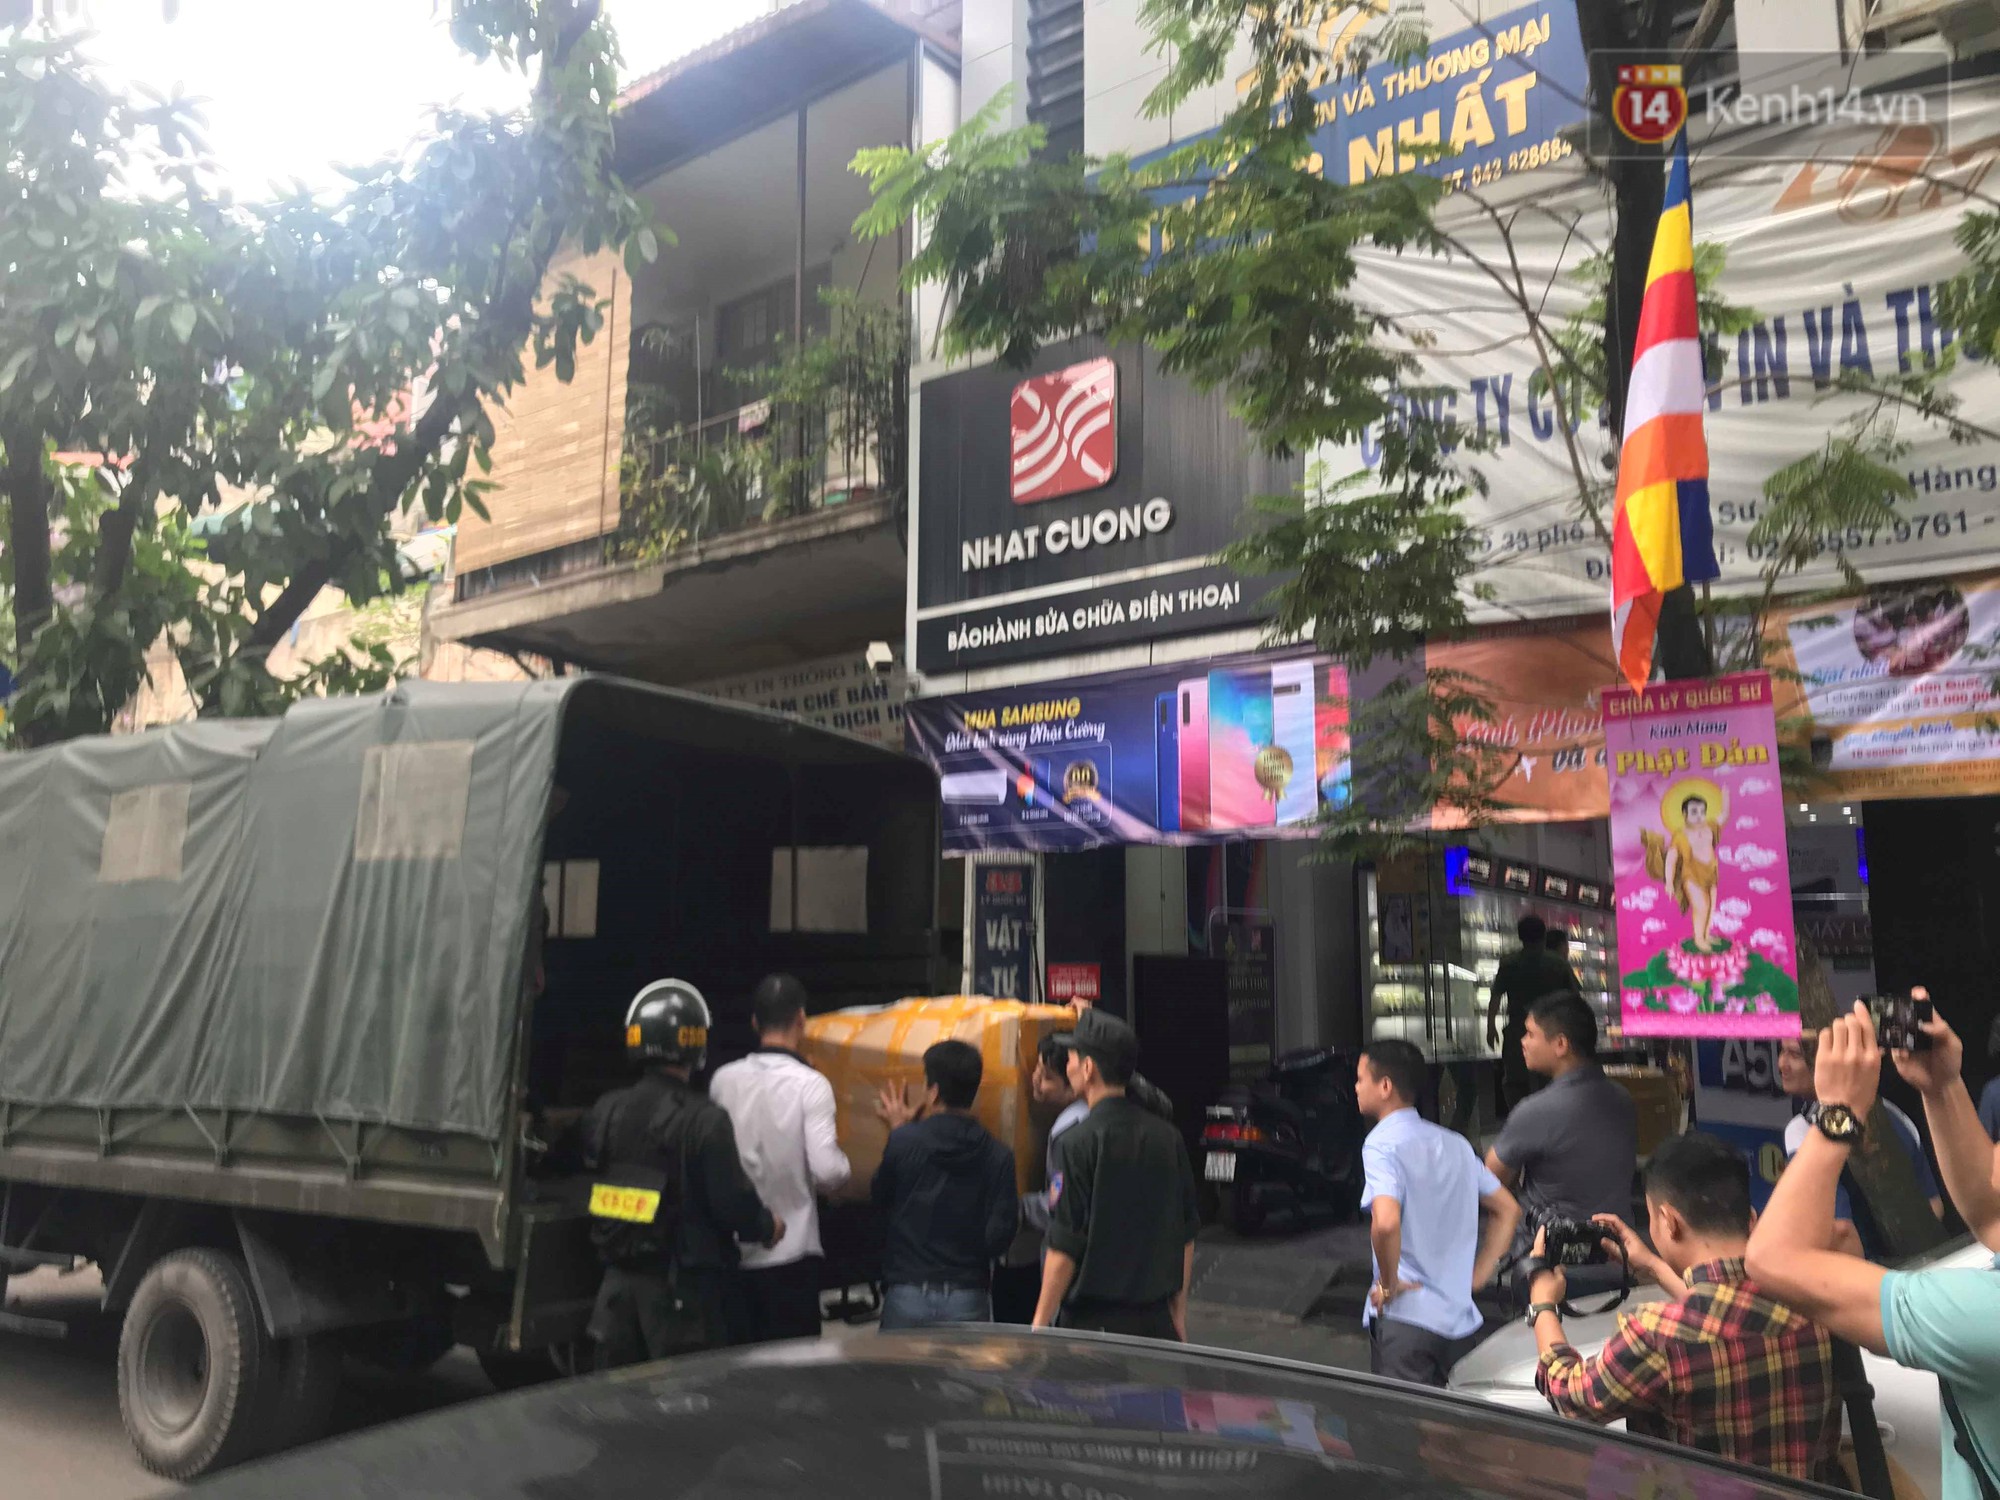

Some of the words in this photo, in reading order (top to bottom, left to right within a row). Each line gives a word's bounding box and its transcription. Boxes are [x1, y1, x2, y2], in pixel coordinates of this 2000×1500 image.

[1342, 77, 1376, 116] VÀ
[1382, 37, 1490, 101] THƯƠNG
[1494, 13, 1551, 59] MẠI
[1348, 68, 1537, 186] NHẤT
[1470, 372, 1514, 450] TY
[1737, 315, 1790, 406] IN
[1803, 281, 1875, 393] VÀ
[1907, 462, 1998, 496] Hàng
[962, 524, 1041, 573] NHAT
[1045, 497, 1172, 555] CUONG
[1128, 590, 1174, 623] ĐIỆN
[1178, 580, 1241, 613] THOẠI
[963, 708, 997, 731] MUA
[1001, 695, 1081, 727] SAMSUNG
[1615, 747, 1691, 779] Phật
[986, 914, 1022, 957] VẬT
